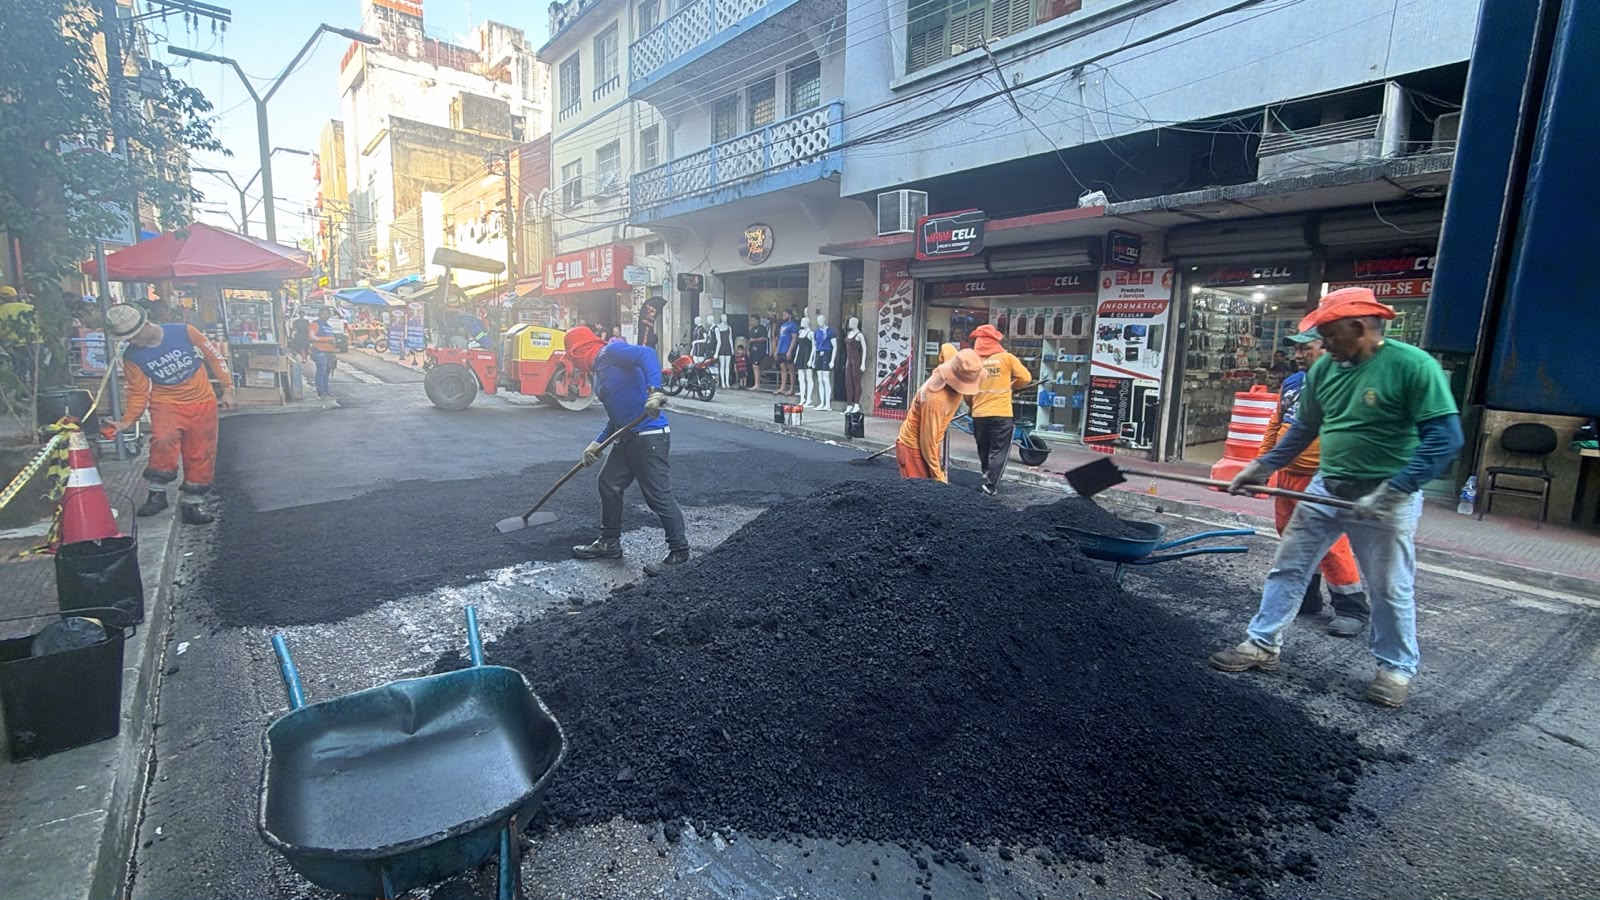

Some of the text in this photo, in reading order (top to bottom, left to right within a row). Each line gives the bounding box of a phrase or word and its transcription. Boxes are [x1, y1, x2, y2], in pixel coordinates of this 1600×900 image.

[952, 228, 976, 240] CELL
[965, 282, 986, 291] CELL
[1054, 276, 1080, 286] CELL
[147, 349, 182, 370] PLANO
